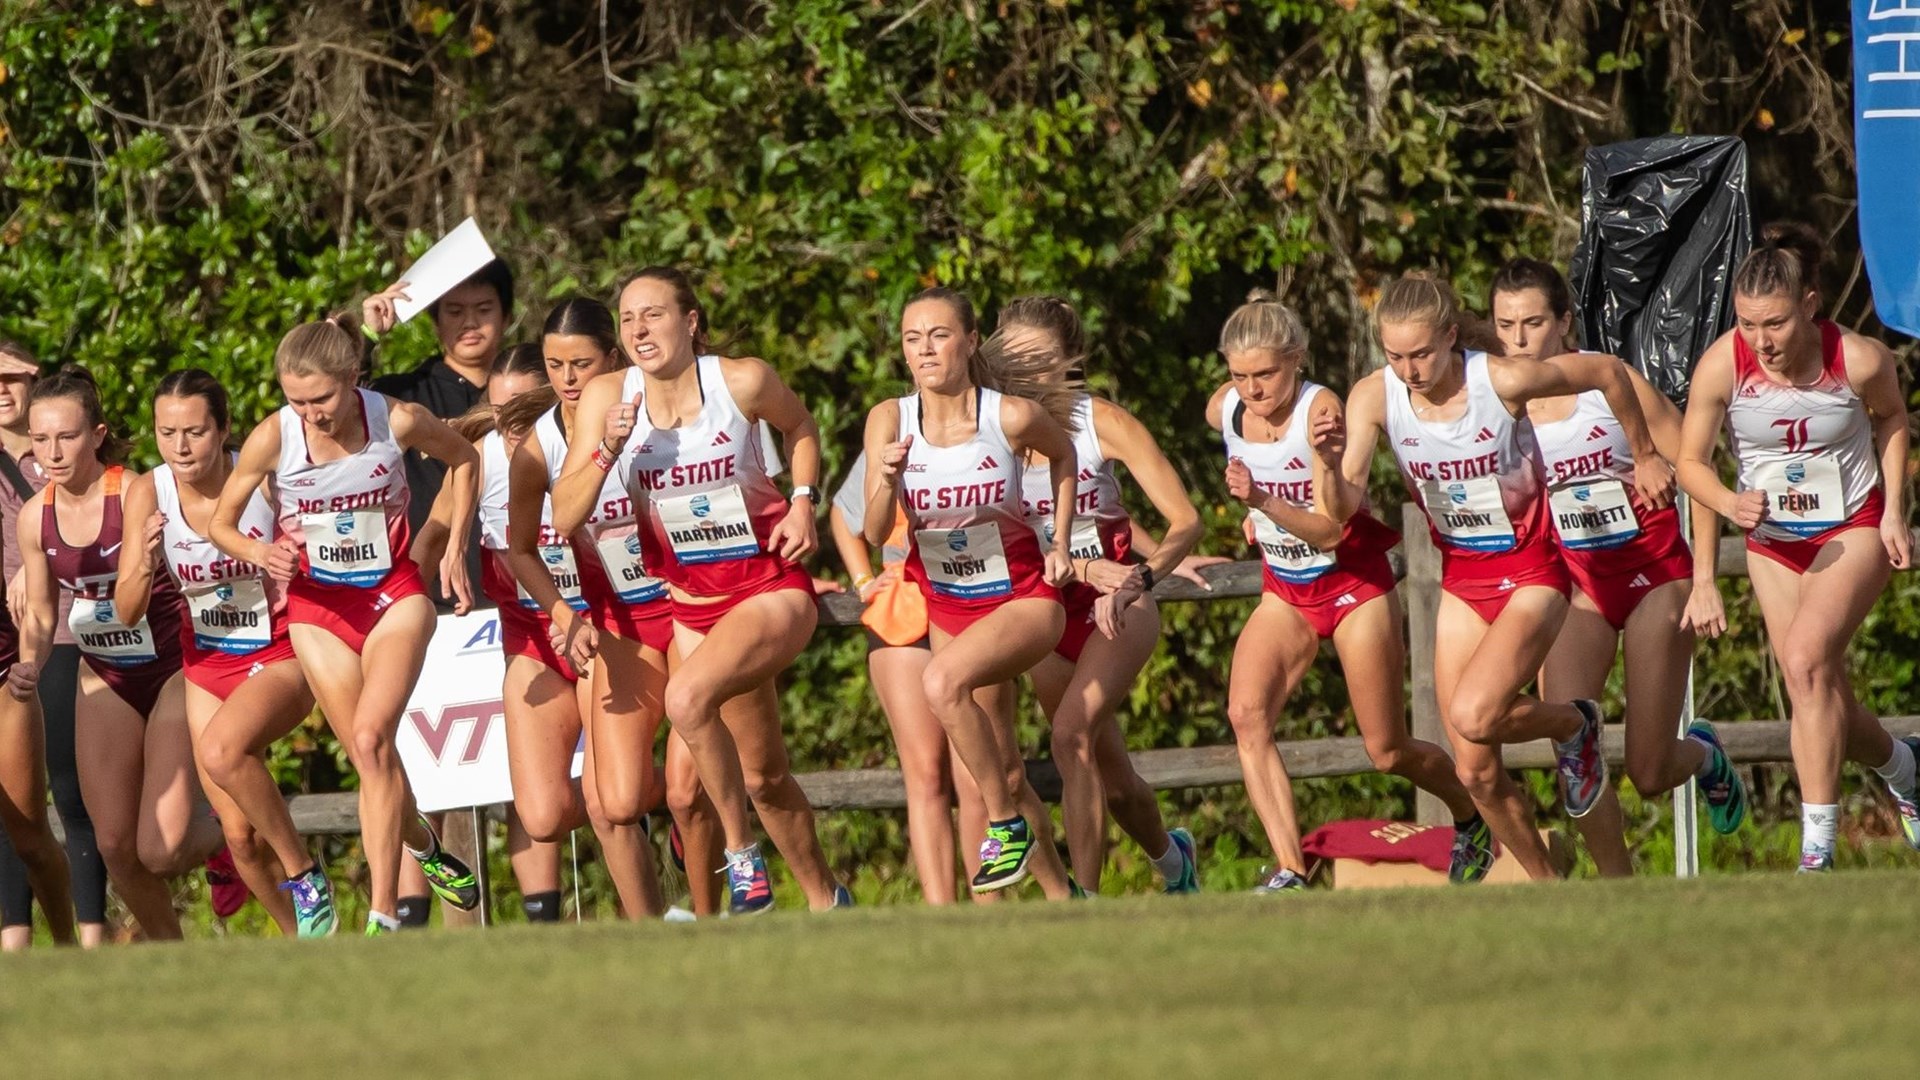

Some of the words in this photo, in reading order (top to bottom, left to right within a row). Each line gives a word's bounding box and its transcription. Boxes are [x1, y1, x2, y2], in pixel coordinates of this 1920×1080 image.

[638, 468, 666, 492] NC
[671, 454, 736, 487] STATE
[1408, 460, 1435, 482] NC
[1438, 450, 1500, 481] STATE
[1552, 445, 1615, 482] STATE
[297, 498, 325, 514] NC
[330, 484, 393, 513] STATE
[903, 487, 931, 511] NC
[936, 479, 1007, 510] STATE
[1778, 493, 1820, 511] PENN
[1441, 512, 1493, 528] TUOHY
[1558, 504, 1628, 531] HOWLETT
[670, 521, 750, 544] HARTMAN
[319, 542, 379, 563] CHMIEL
[177, 563, 205, 582] NC
[941, 558, 987, 578] BUSH
[200, 608, 259, 628] QUARZO
[80, 628, 144, 648] WATERS
